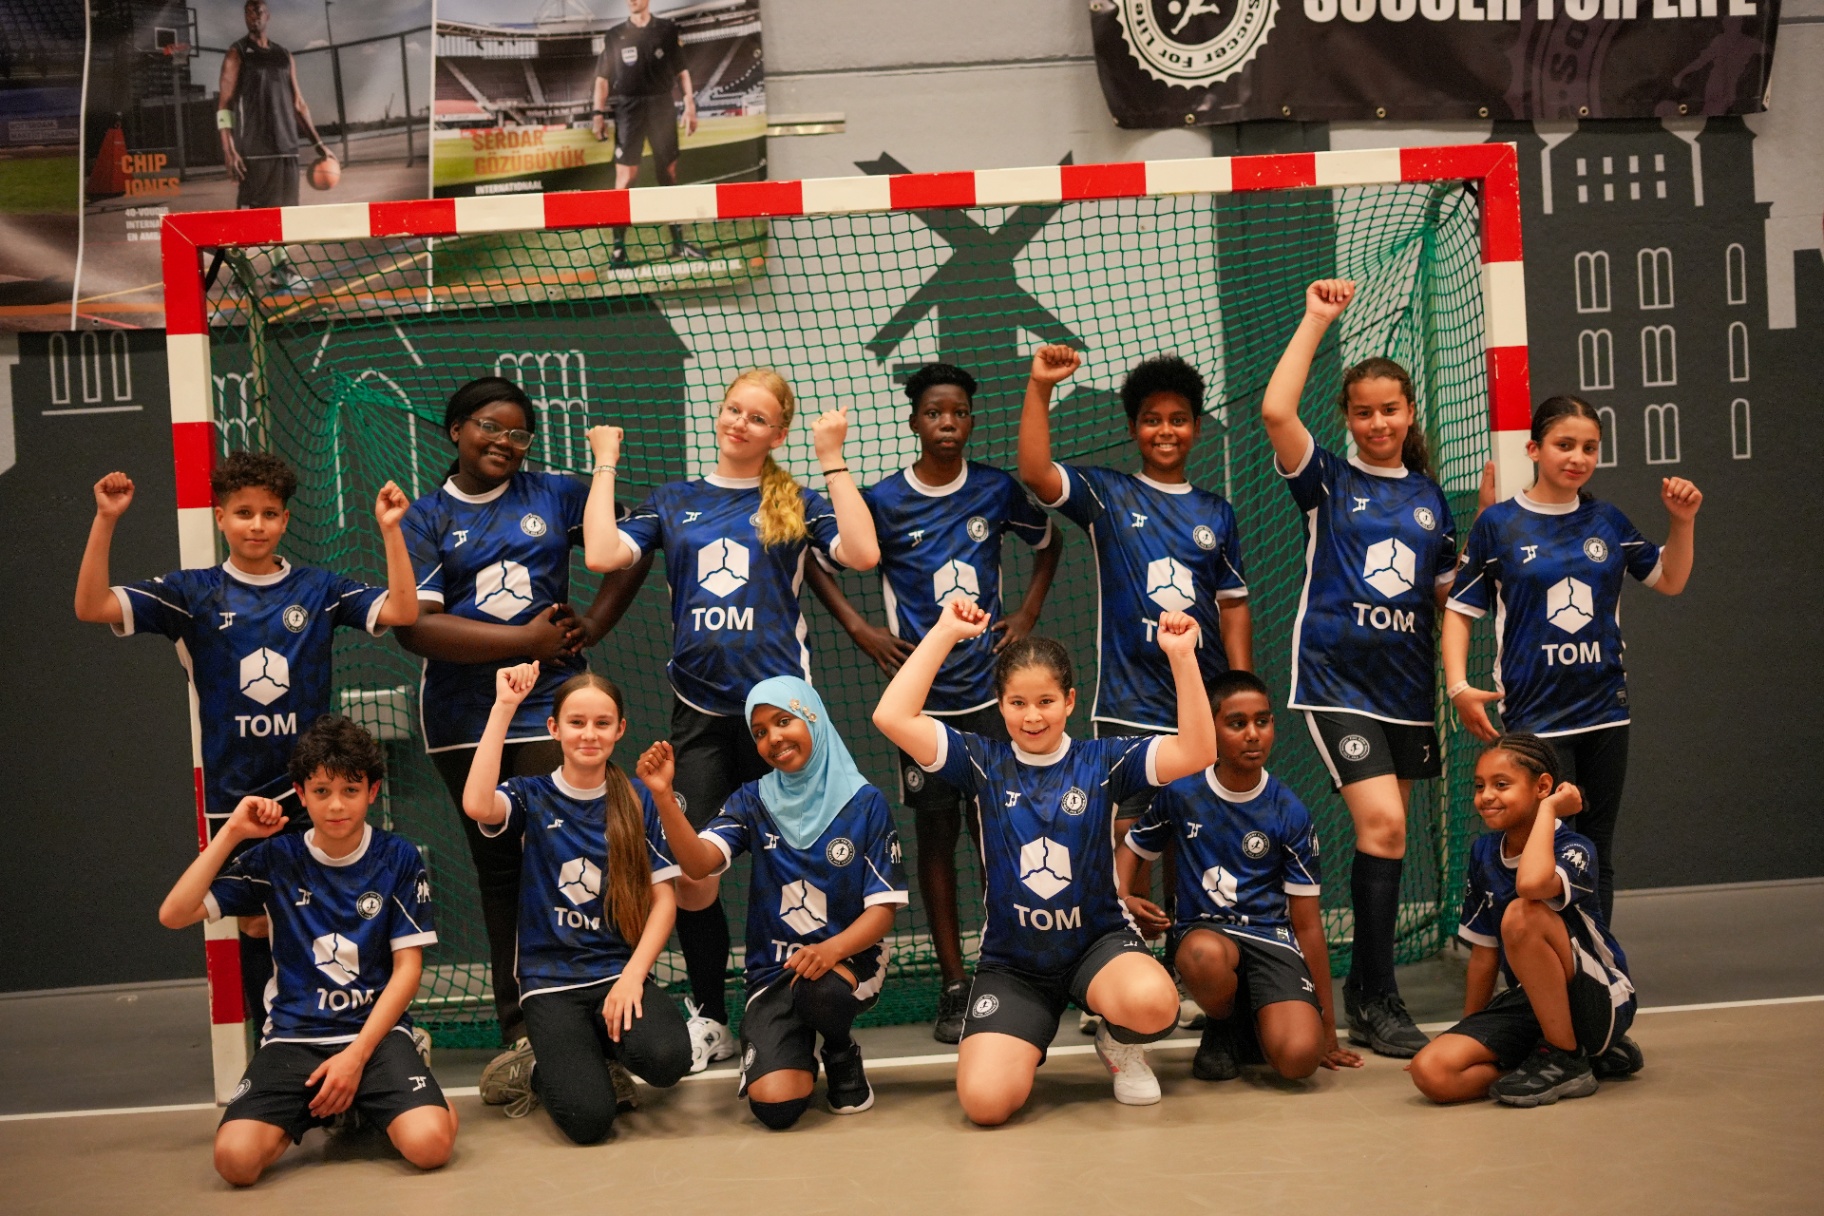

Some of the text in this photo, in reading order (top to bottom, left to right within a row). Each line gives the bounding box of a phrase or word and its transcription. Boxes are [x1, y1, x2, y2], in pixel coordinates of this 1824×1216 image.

[1135, 3, 1155, 47] Life
[1158, 49, 1193, 68] For
[472, 130, 544, 151] SERDAR
[121, 153, 167, 174] CHIP
[474, 146, 586, 175] GÖZÜBÜYÜK
[124, 177, 180, 198] JONES
[475, 181, 544, 195] INTERNATIONAAL
[691, 606, 754, 631] TOM
[1353, 602, 1415, 634] TOM
[1541, 641, 1601, 666] TOM
[235, 712, 297, 737] TOM
[554, 906, 600, 931] TOM
[1013, 903, 1082, 931] TOM
